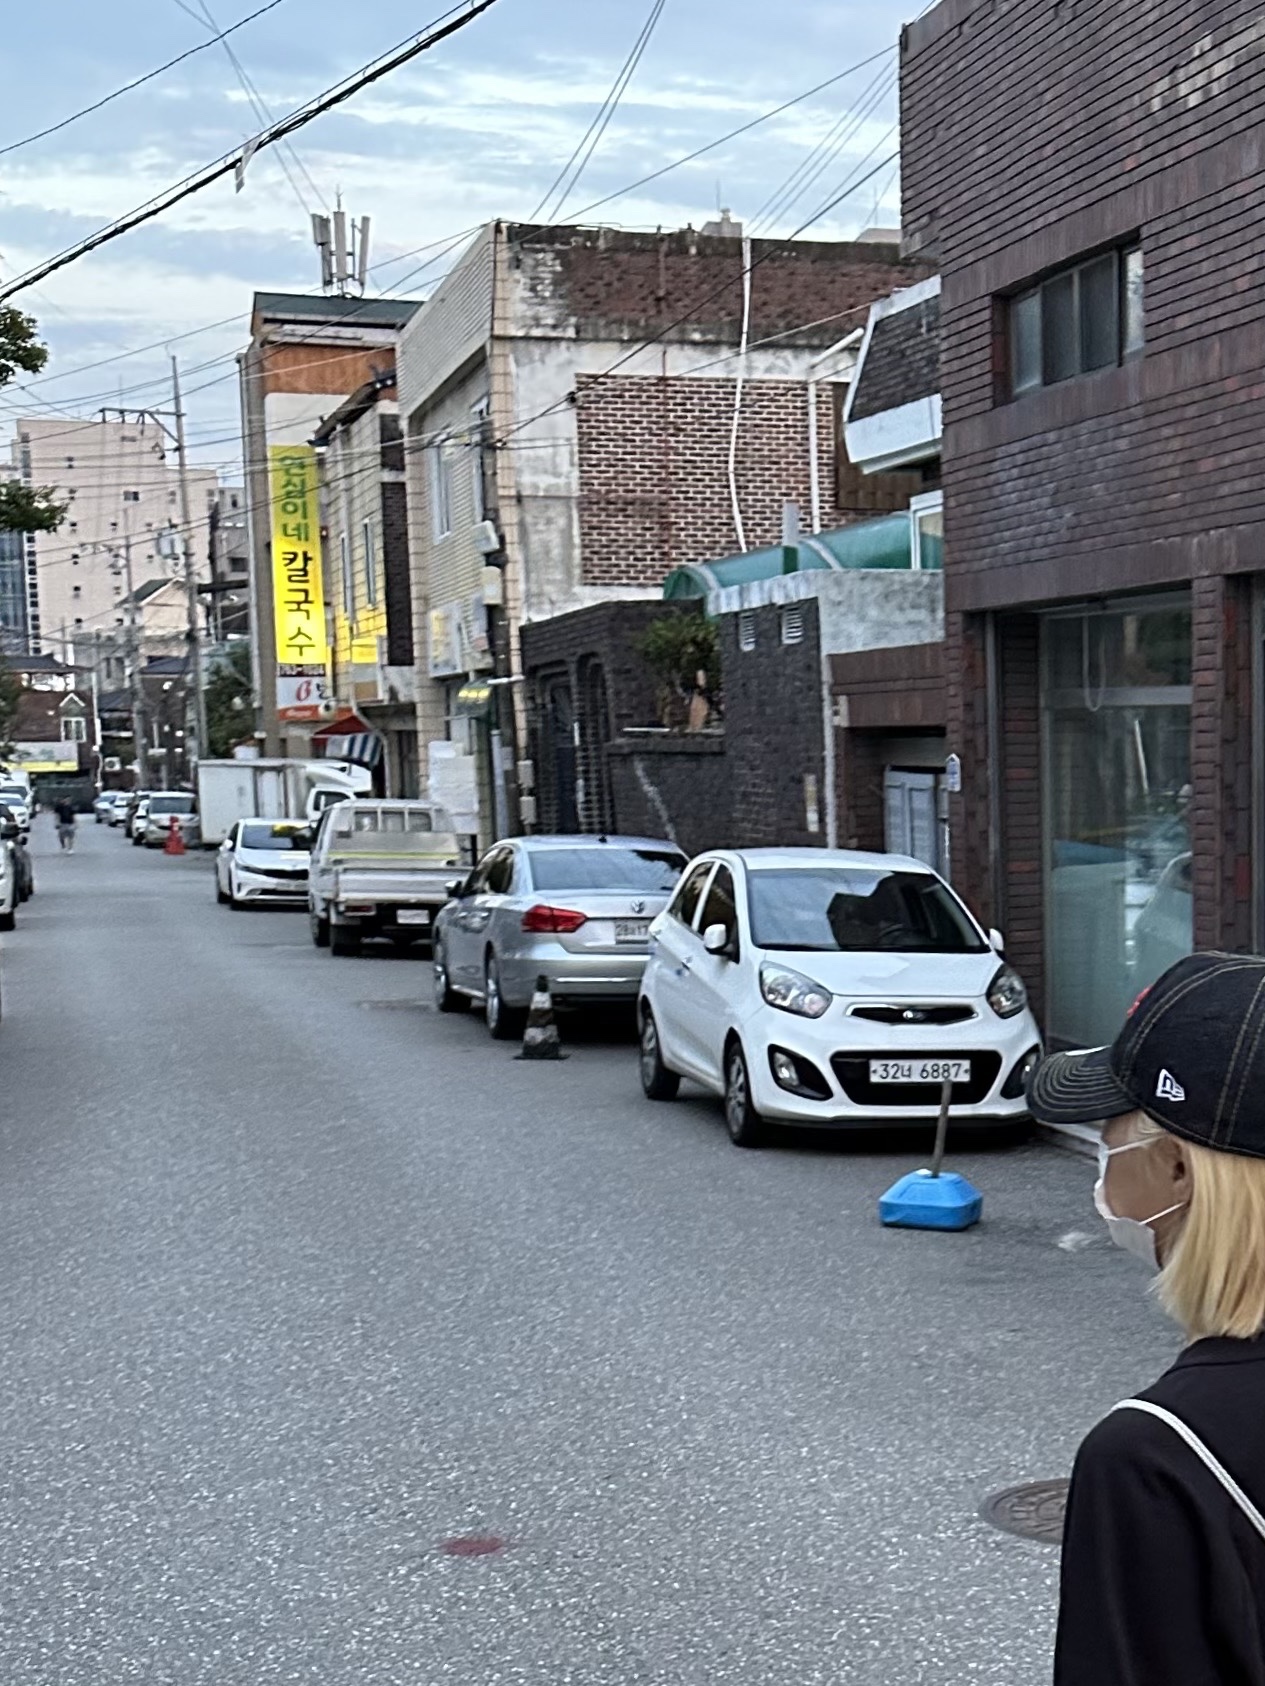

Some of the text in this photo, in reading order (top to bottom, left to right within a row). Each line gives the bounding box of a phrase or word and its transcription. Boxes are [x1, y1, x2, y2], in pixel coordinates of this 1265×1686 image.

[281, 551, 315, 657] 칼국수
[880, 1063, 962, 1080] 32너 6887
